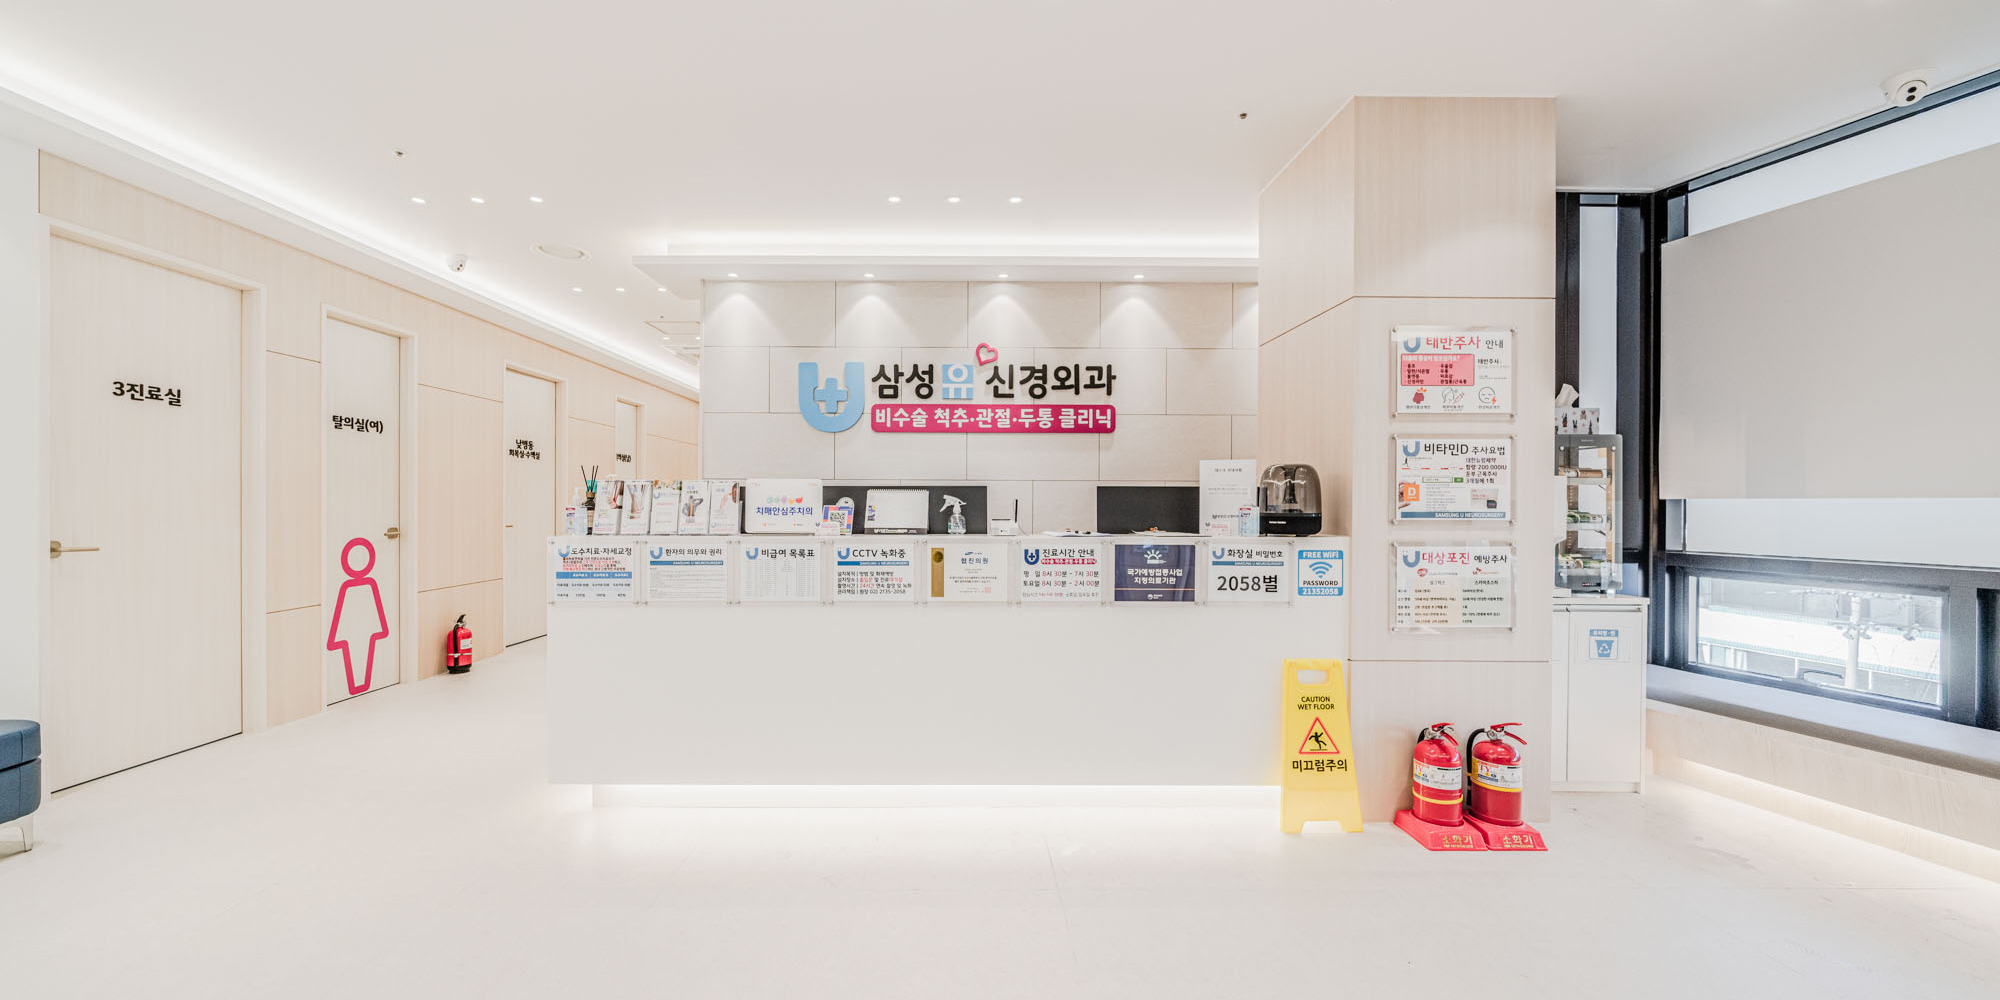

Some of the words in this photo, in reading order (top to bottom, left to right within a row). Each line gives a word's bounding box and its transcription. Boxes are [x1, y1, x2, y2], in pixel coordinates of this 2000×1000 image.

[1426, 336, 1480, 350] 태반주사
[1485, 339, 1504, 350] 안내
[112, 381, 182, 407] 3진료실
[875, 408, 928, 429] 비수술
[1058, 408, 1112, 429] 클리닉
[332, 415, 384, 434] 탈의실(여)
[1424, 443, 1469, 456] 비타민D
[1471, 446, 1505, 455] 주사요법
[756, 506, 813, 516] 치매안심주치의
[571, 547, 632, 556] 도수치료·자세교정
[665, 548, 685, 556] 환자의
[687, 548, 707, 556] 의무와
[708, 548, 722, 556] 권리
[761, 549, 787, 558] 비급여
[789, 549, 815, 558] 목록표
[852, 549, 878, 557] CCTV
[880, 548, 906, 558] 녹화중
[1042, 548, 1075, 558] 진료시간
[1077, 548, 1095, 558] 안내
[1227, 549, 1253, 558] 화장실
[1255, 550, 1283, 558] 비밀번호
[1422, 552, 1470, 565] 대상포진
[1473, 555, 1508, 564] 예방주사
[1127, 568, 1183, 576] 국가예방접종사업
[1217, 575, 1278, 593] 2058별
[1292, 759, 1348, 772] 미끄럼주의
[1442, 835, 1473, 845] 소화기
[1503, 835, 1533, 845] 소화기
